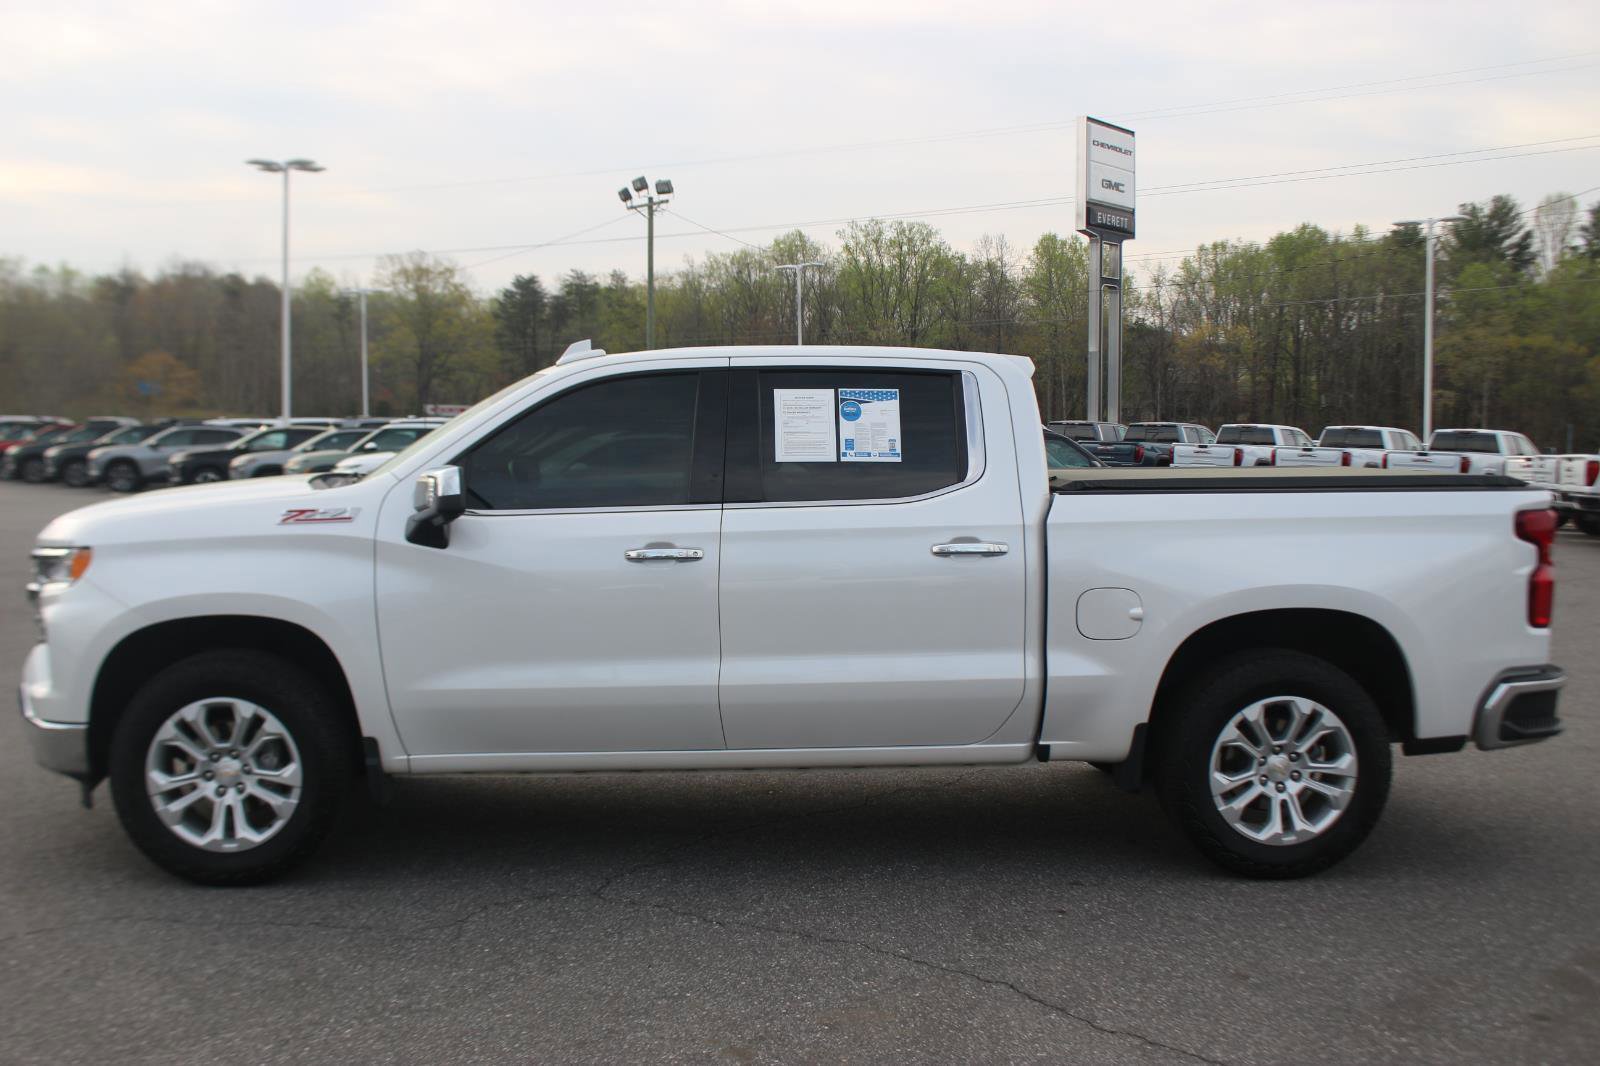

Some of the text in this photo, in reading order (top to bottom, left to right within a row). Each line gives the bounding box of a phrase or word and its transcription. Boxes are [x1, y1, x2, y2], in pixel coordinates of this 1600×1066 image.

[1092, 139, 1132, 156] CHEVROLET
[1101, 178, 1125, 193] GMC
[1097, 212, 1128, 229] EVERETT
